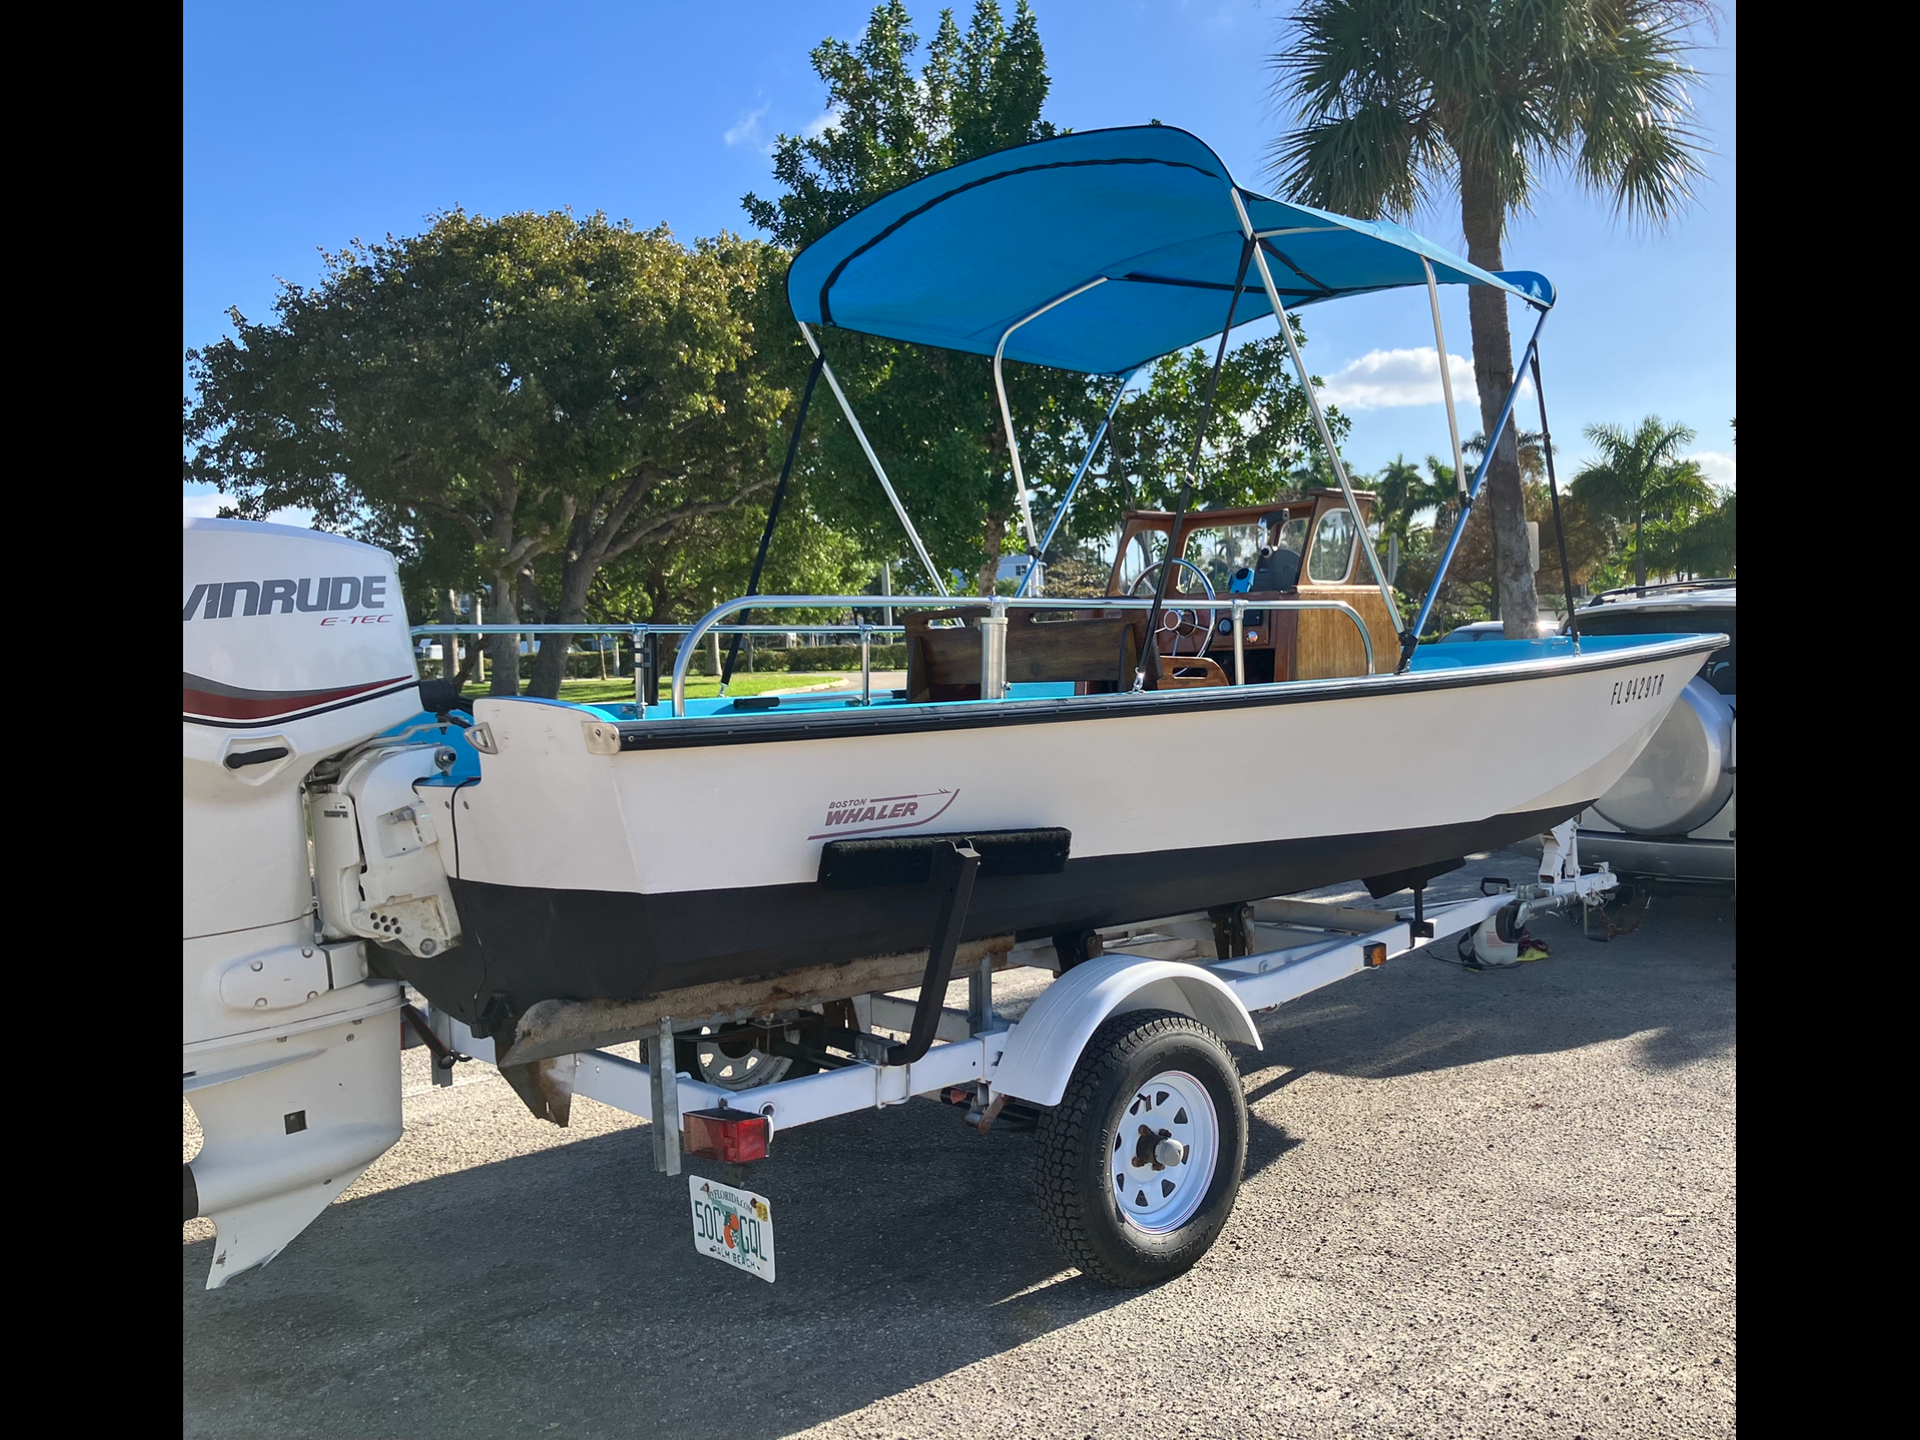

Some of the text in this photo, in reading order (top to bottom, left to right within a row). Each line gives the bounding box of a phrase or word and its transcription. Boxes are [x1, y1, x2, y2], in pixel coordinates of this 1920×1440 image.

[320, 614, 393, 626] E-TEC
[829, 798, 867, 809] BOSTON
[825, 802, 918, 826] WHALER
[733, 1252, 756, 1269] BEACH
